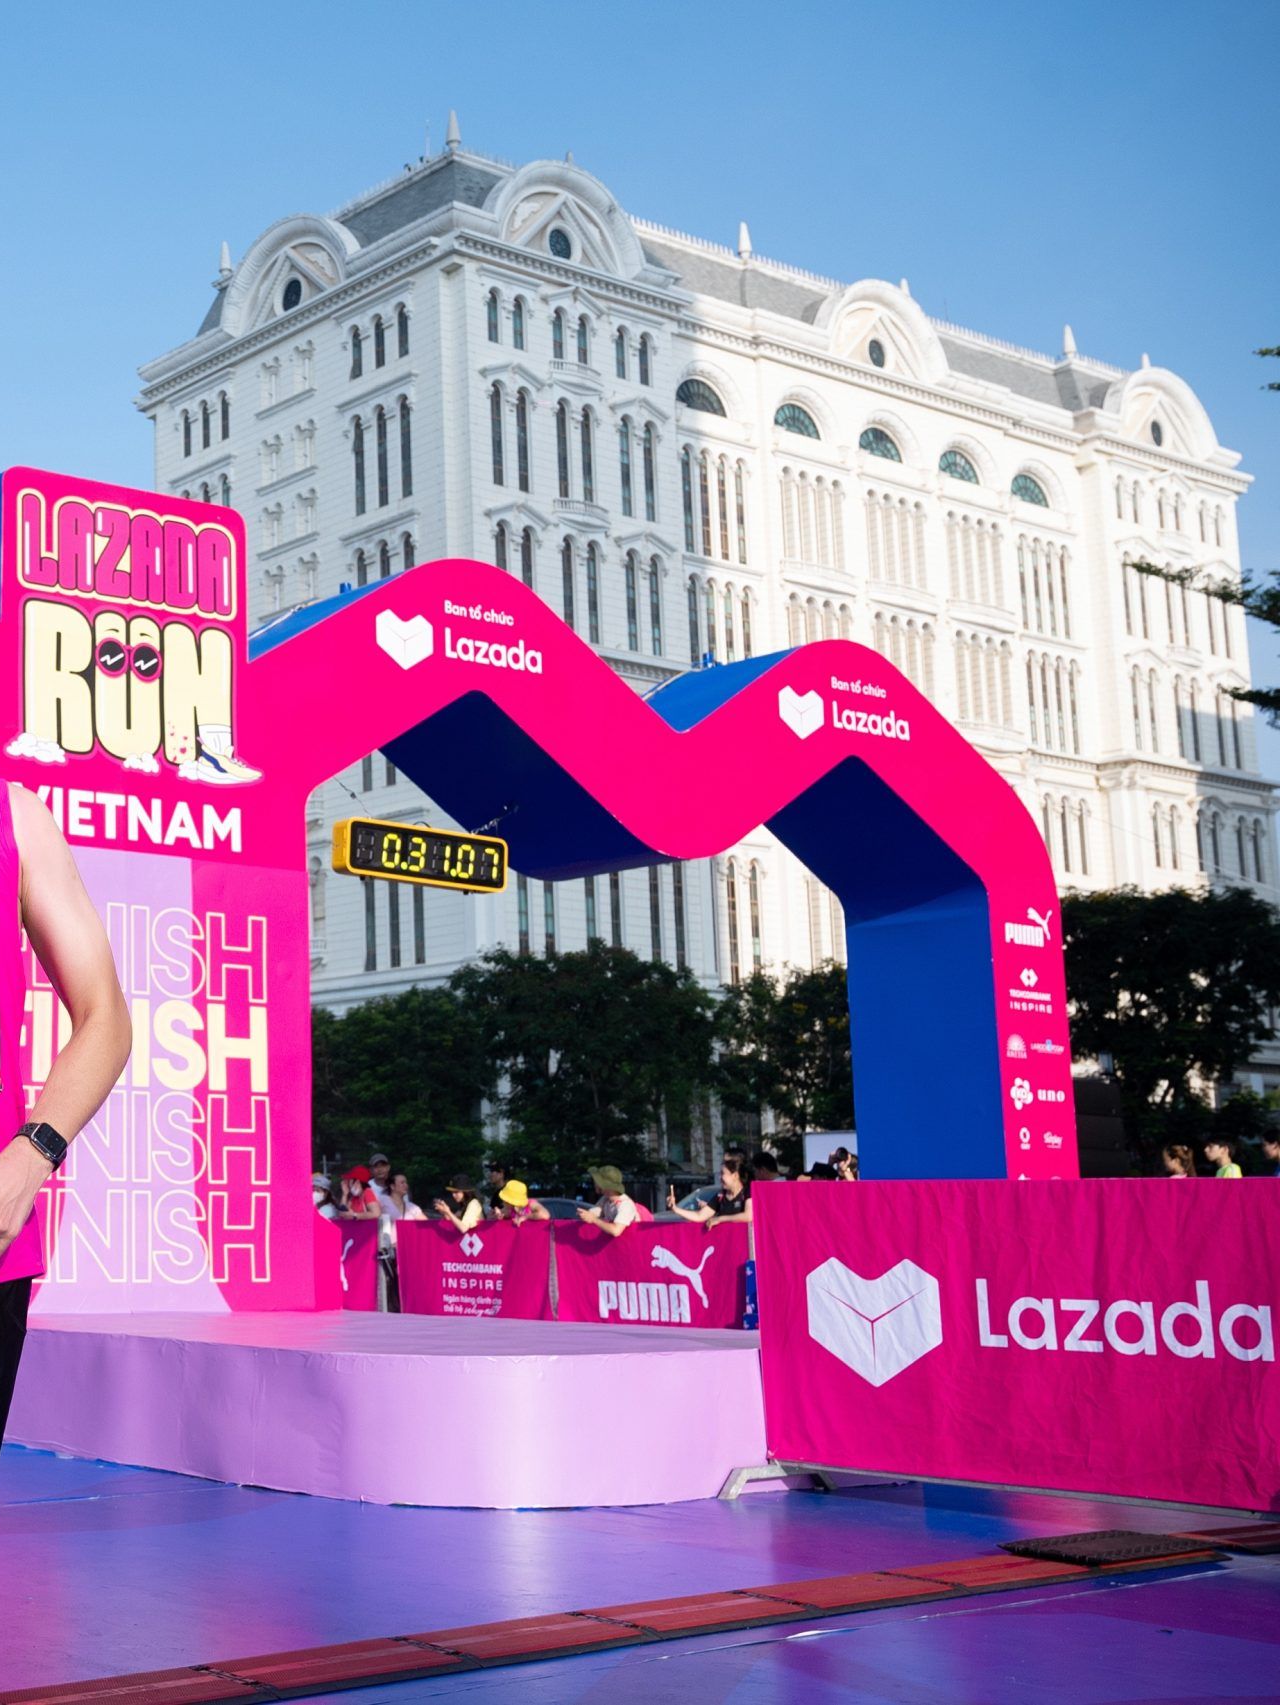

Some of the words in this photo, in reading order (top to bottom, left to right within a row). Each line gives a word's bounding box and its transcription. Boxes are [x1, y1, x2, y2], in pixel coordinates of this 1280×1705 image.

[19, 490, 235, 619] LAZADA
[444, 600, 468, 618] Ban
[469, 604, 482, 621] tổ
[483, 608, 514, 627] chức
[444, 626, 543, 675] Lazada
[22, 598, 234, 766] RUN
[830, 676, 850, 692] Ban
[832, 700, 911, 742] Lazada
[11, 781, 243, 853] IETNAM
[1009, 1001, 1053, 1014] INSPIRE
[1037, 1088, 1066, 1103] uno
[442, 1262, 503, 1274] TECHCOMBANK
[442, 1277, 503, 1291] INSPIRE
[598, 1280, 692, 1323] PUMA
[975, 1278, 1276, 1363] Lazada
